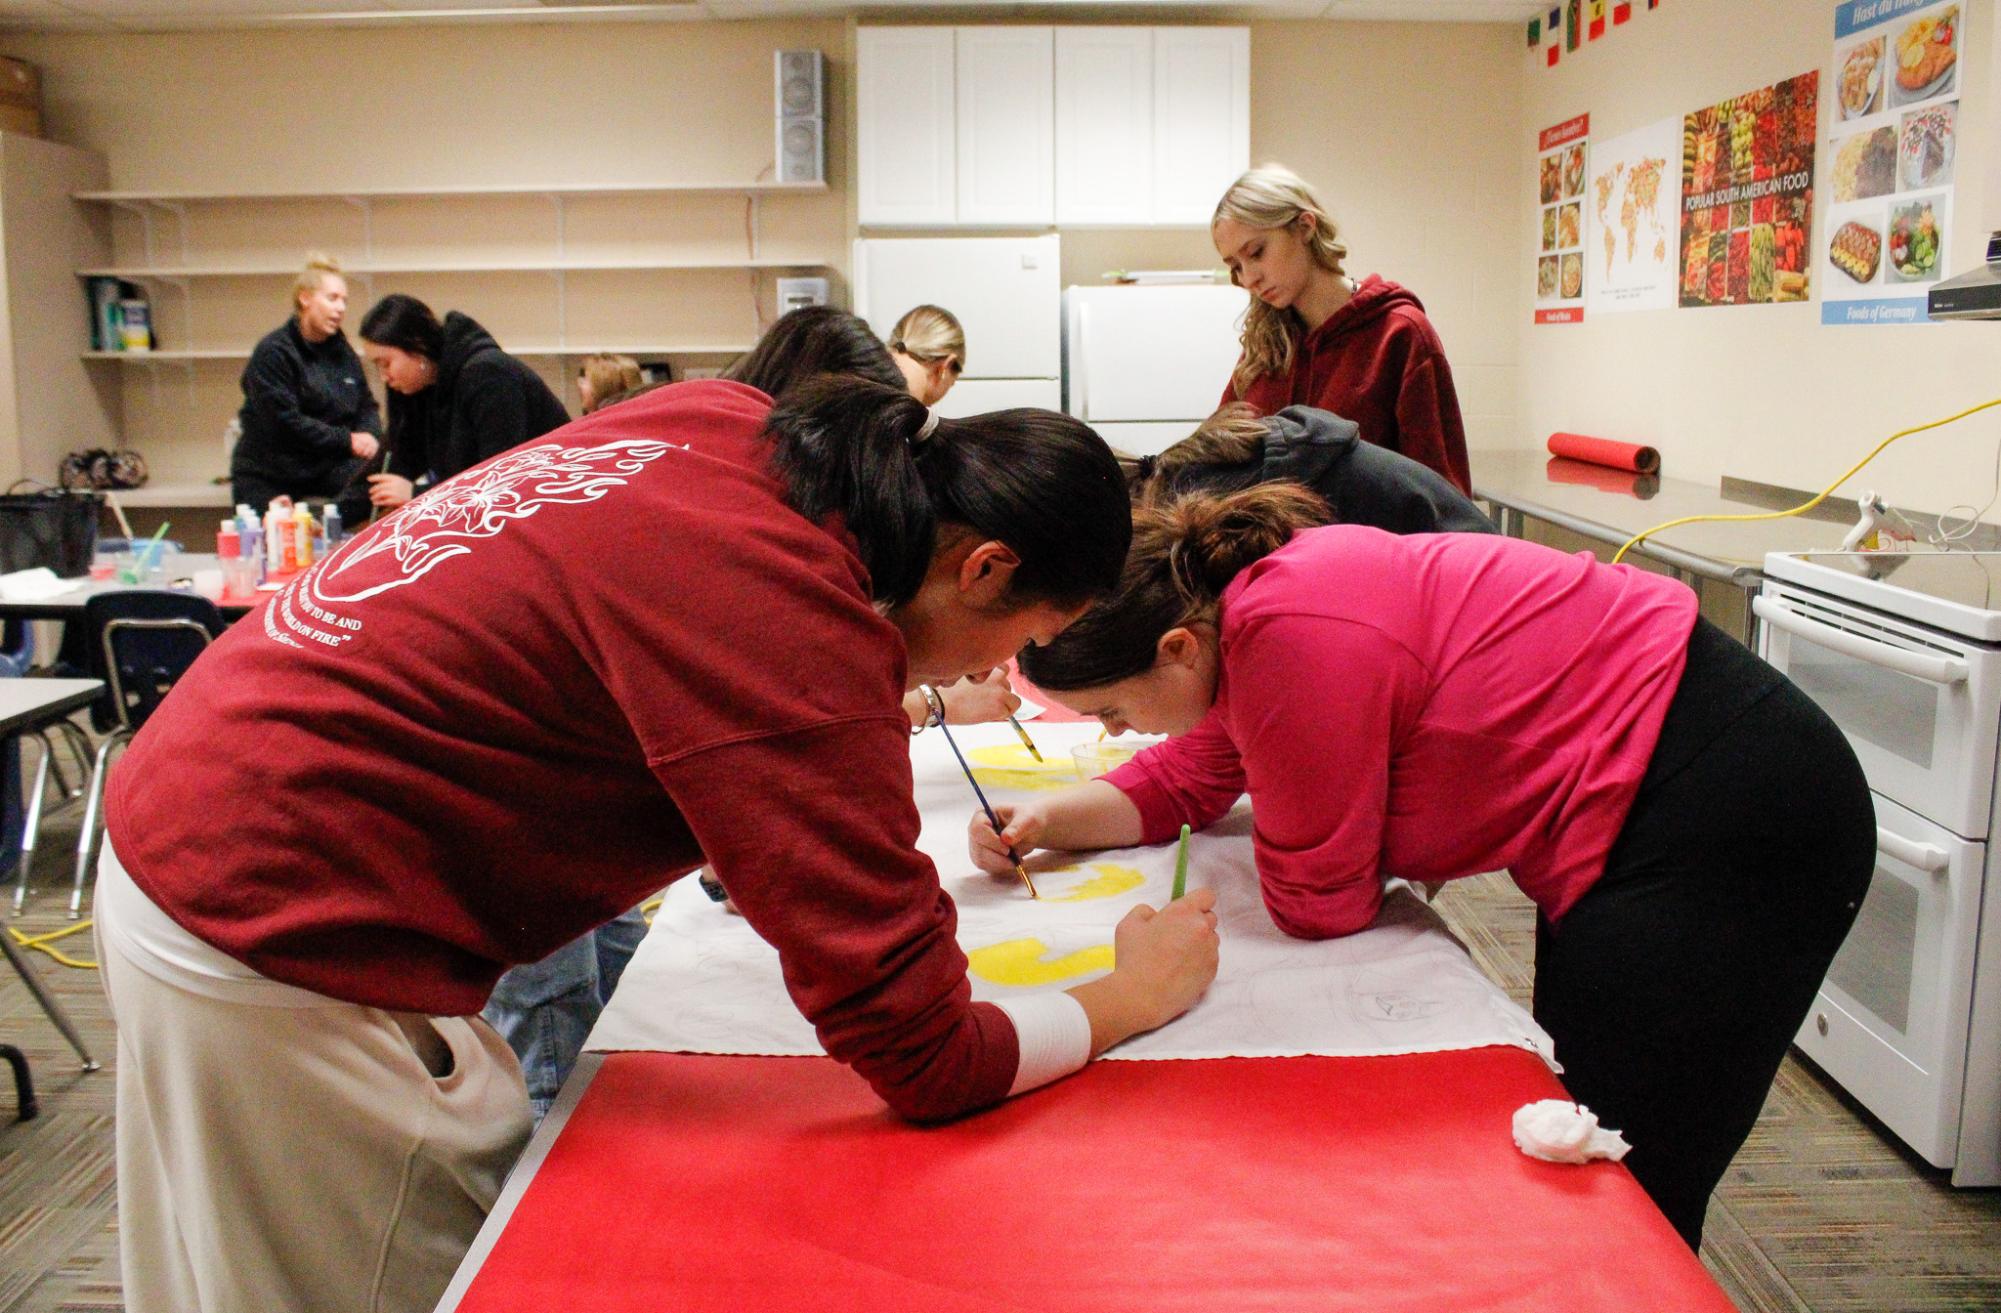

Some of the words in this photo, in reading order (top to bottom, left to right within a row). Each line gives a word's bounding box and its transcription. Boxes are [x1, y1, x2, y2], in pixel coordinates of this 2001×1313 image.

[1853, 3, 1876, 25] Hast
[1686, 194, 1715, 211] POPULAR
[1716, 187, 1739, 205] SOUTH
[1740, 178, 1782, 199] AMERICAN
[1783, 171, 1809, 192] FOOD
[1847, 306, 1869, 320] Foods
[1870, 305, 1880, 323] of
[1879, 305, 1917, 321] Germany
[310, 606, 324, 619] TO
[321, 611, 337, 624] BE
[335, 616, 363, 631] AND
[298, 624, 315, 636] ON
